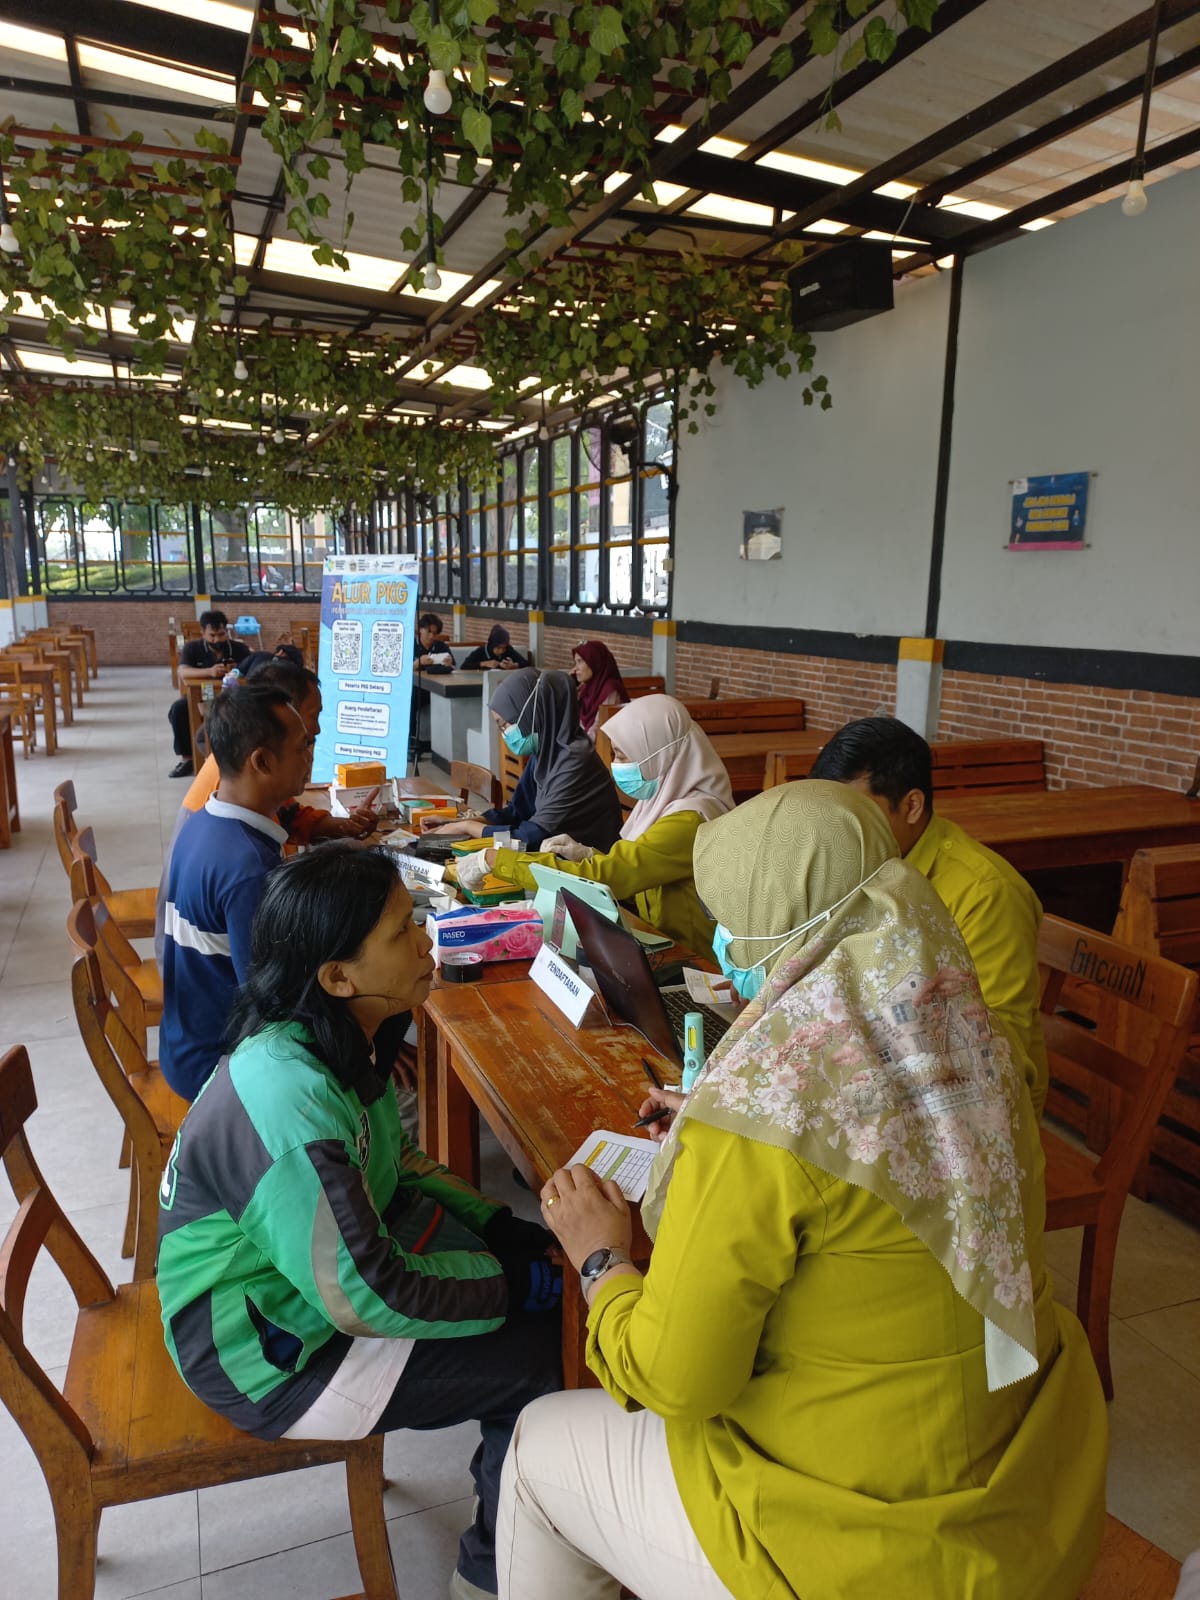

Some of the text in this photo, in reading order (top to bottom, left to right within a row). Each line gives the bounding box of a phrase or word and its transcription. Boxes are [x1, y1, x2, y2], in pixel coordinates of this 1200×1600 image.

[331, 581, 408, 605] ALUR PKG
[442, 931, 466, 939] PASEO
[547, 960, 580, 997] PENDAFTARAN
